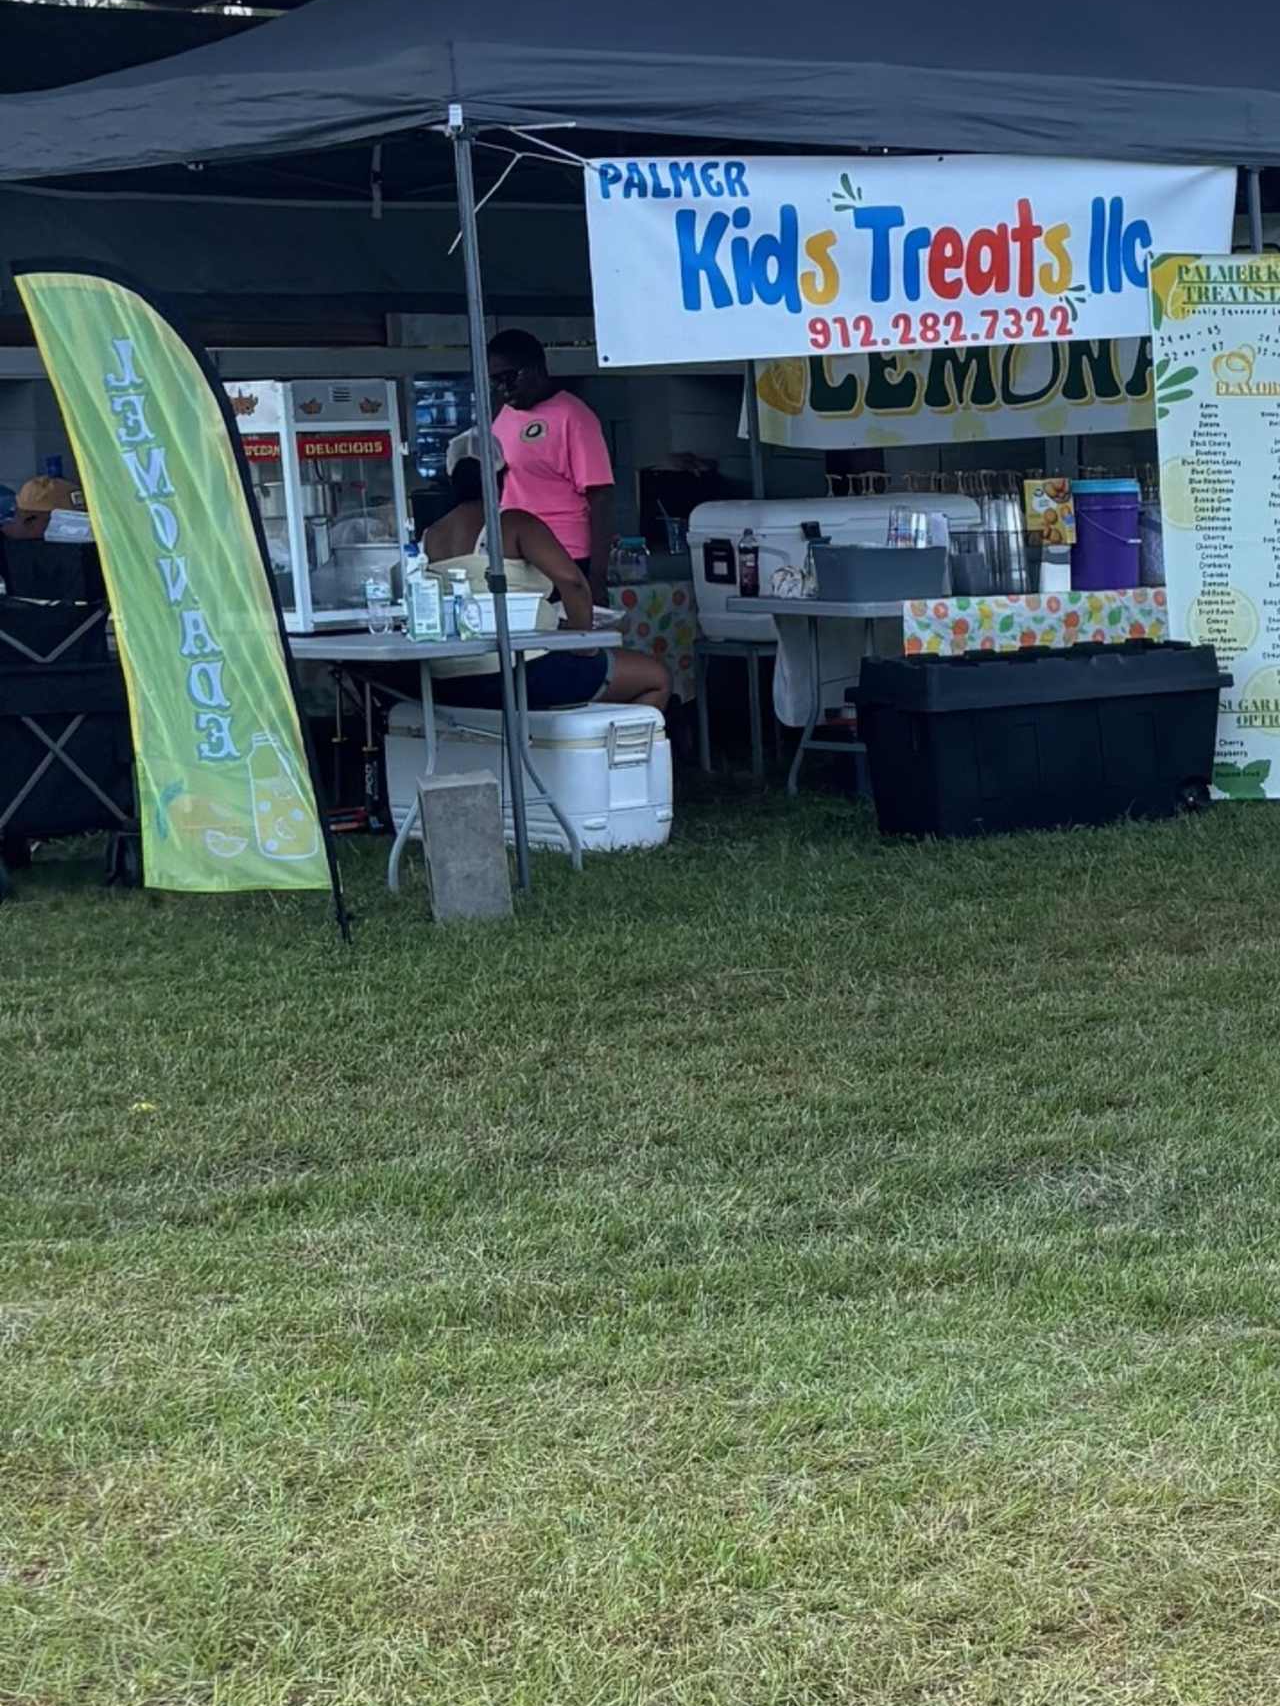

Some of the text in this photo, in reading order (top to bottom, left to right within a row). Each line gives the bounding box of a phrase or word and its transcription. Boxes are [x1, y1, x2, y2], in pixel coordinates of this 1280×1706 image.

[600, 161, 750, 200] PALMER
[675, 196, 1153, 313] Kids Treats llc
[1177, 264, 1261, 282] PALMER
[1184, 286, 1266, 303] TREATS
[808, 304, 1074, 350] 912.282.7322
[305, 441, 383, 456] DELICIOUS
